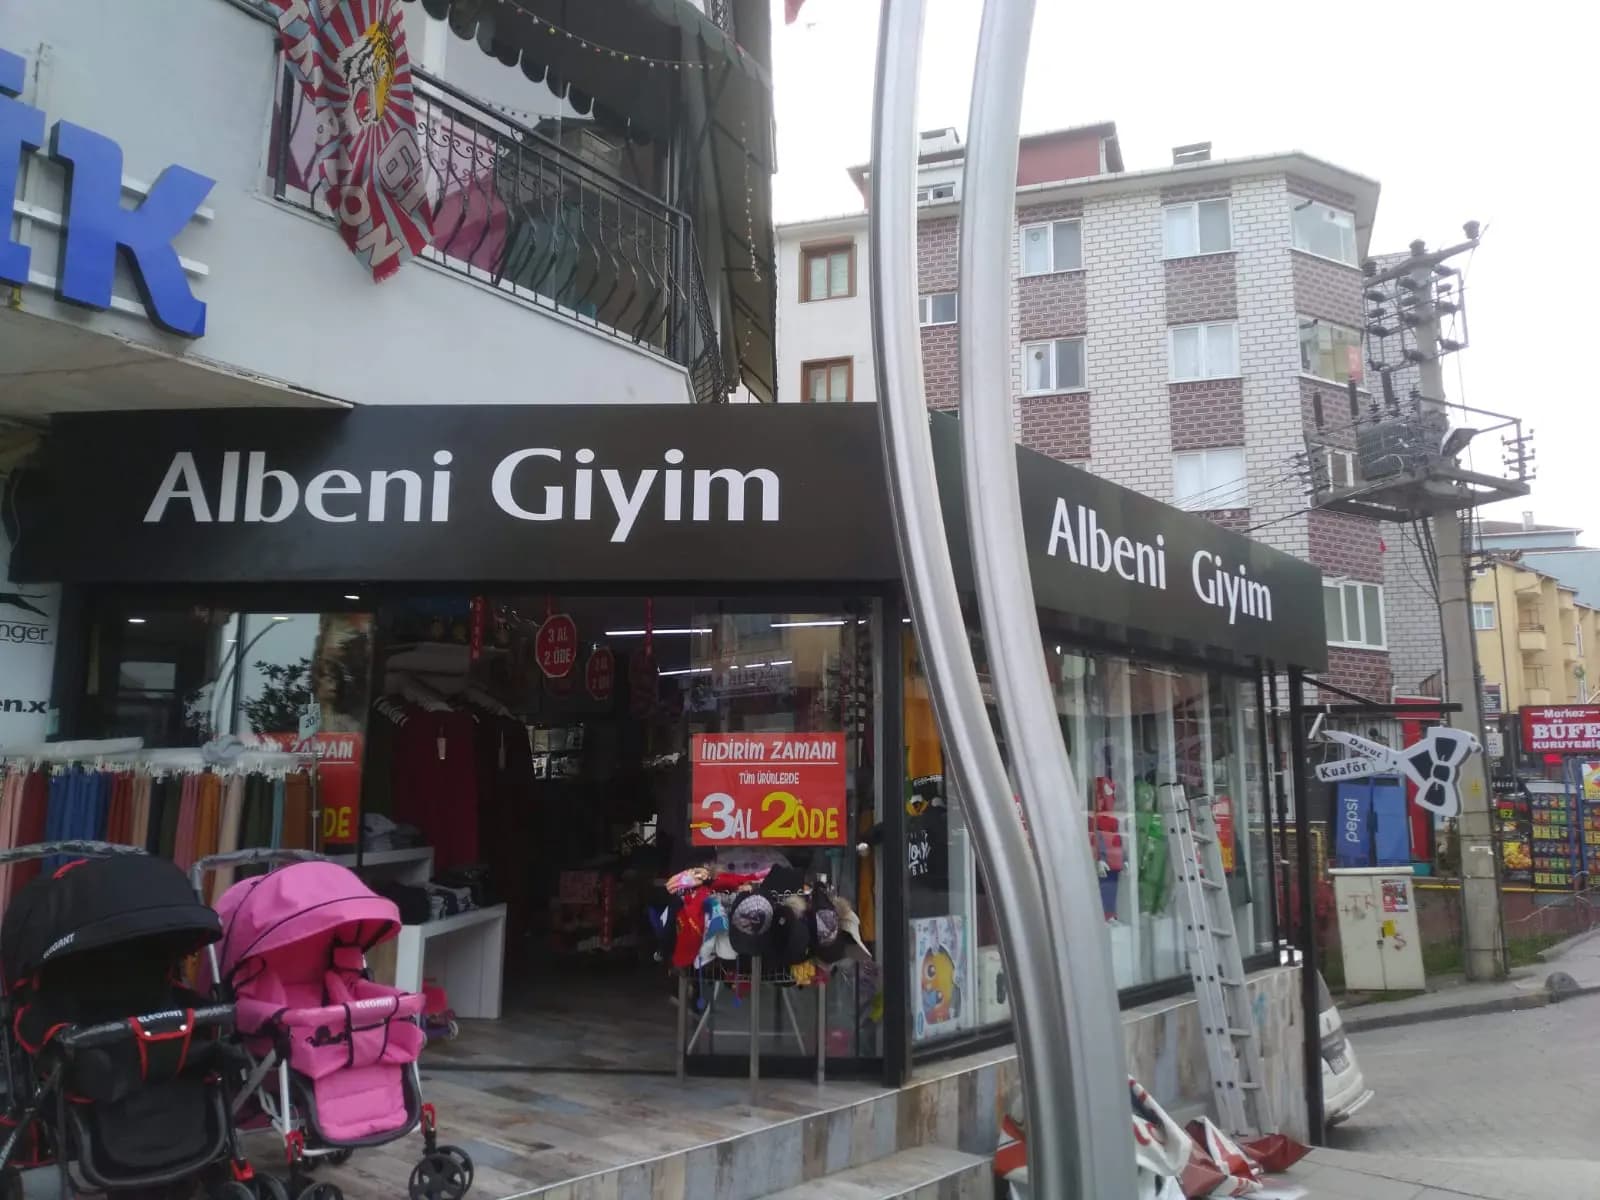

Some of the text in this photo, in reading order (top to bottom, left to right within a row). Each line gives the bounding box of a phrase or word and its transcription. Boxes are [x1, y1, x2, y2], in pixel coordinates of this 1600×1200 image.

[143, 447, 780, 543] Albeni Giyim
[1047, 497, 1272, 625] Albeni Giyim
[1531, 718, 1600, 739] BÜFE
[1349, 737, 1383, 758] Davut
[738, 770, 800, 785] TÜM ÜRÜNLERDE
[1320, 761, 1368, 779] Kuaför
[1343, 798, 1361, 843] pepsi
